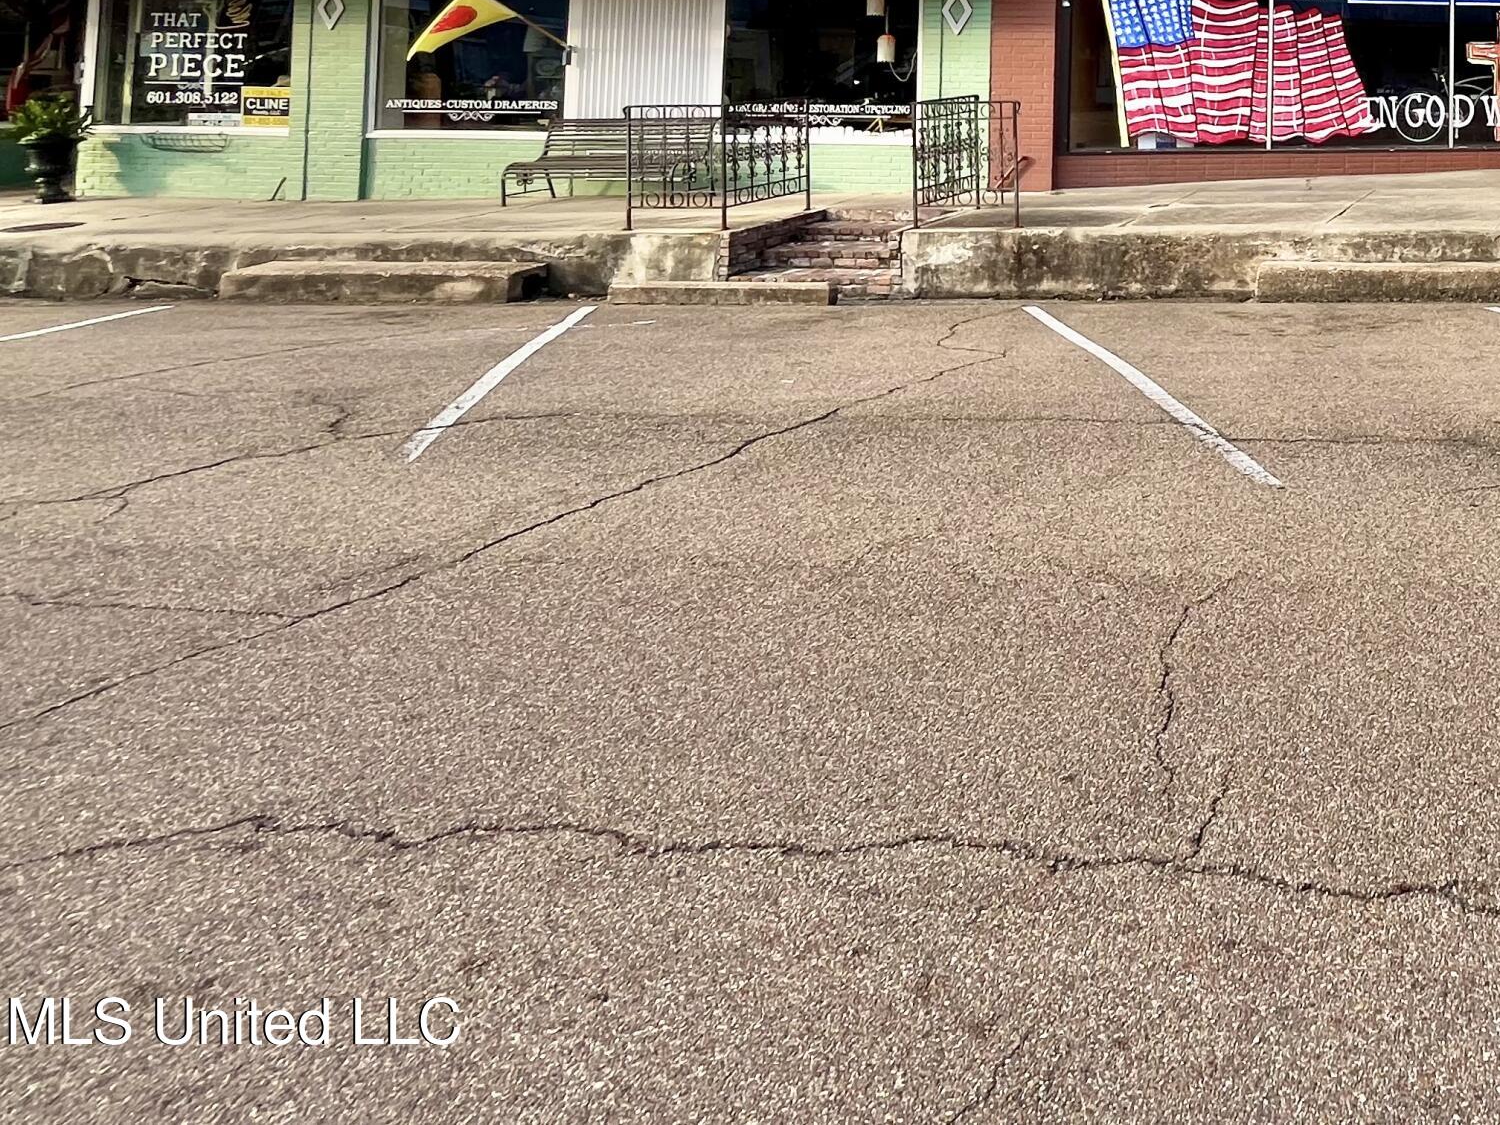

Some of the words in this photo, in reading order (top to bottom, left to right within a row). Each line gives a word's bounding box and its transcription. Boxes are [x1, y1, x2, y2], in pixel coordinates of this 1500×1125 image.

[150, 12, 201, 27] THAT
[151, 32, 248, 49] PERFECT
[148, 53, 246, 78] PIECE
[146, 91, 239, 105] 601.308.5122
[246, 98, 289, 110] CLINE
[494, 101, 558, 110] DRAPERIES
[1404, 93, 1475, 128] GOD
